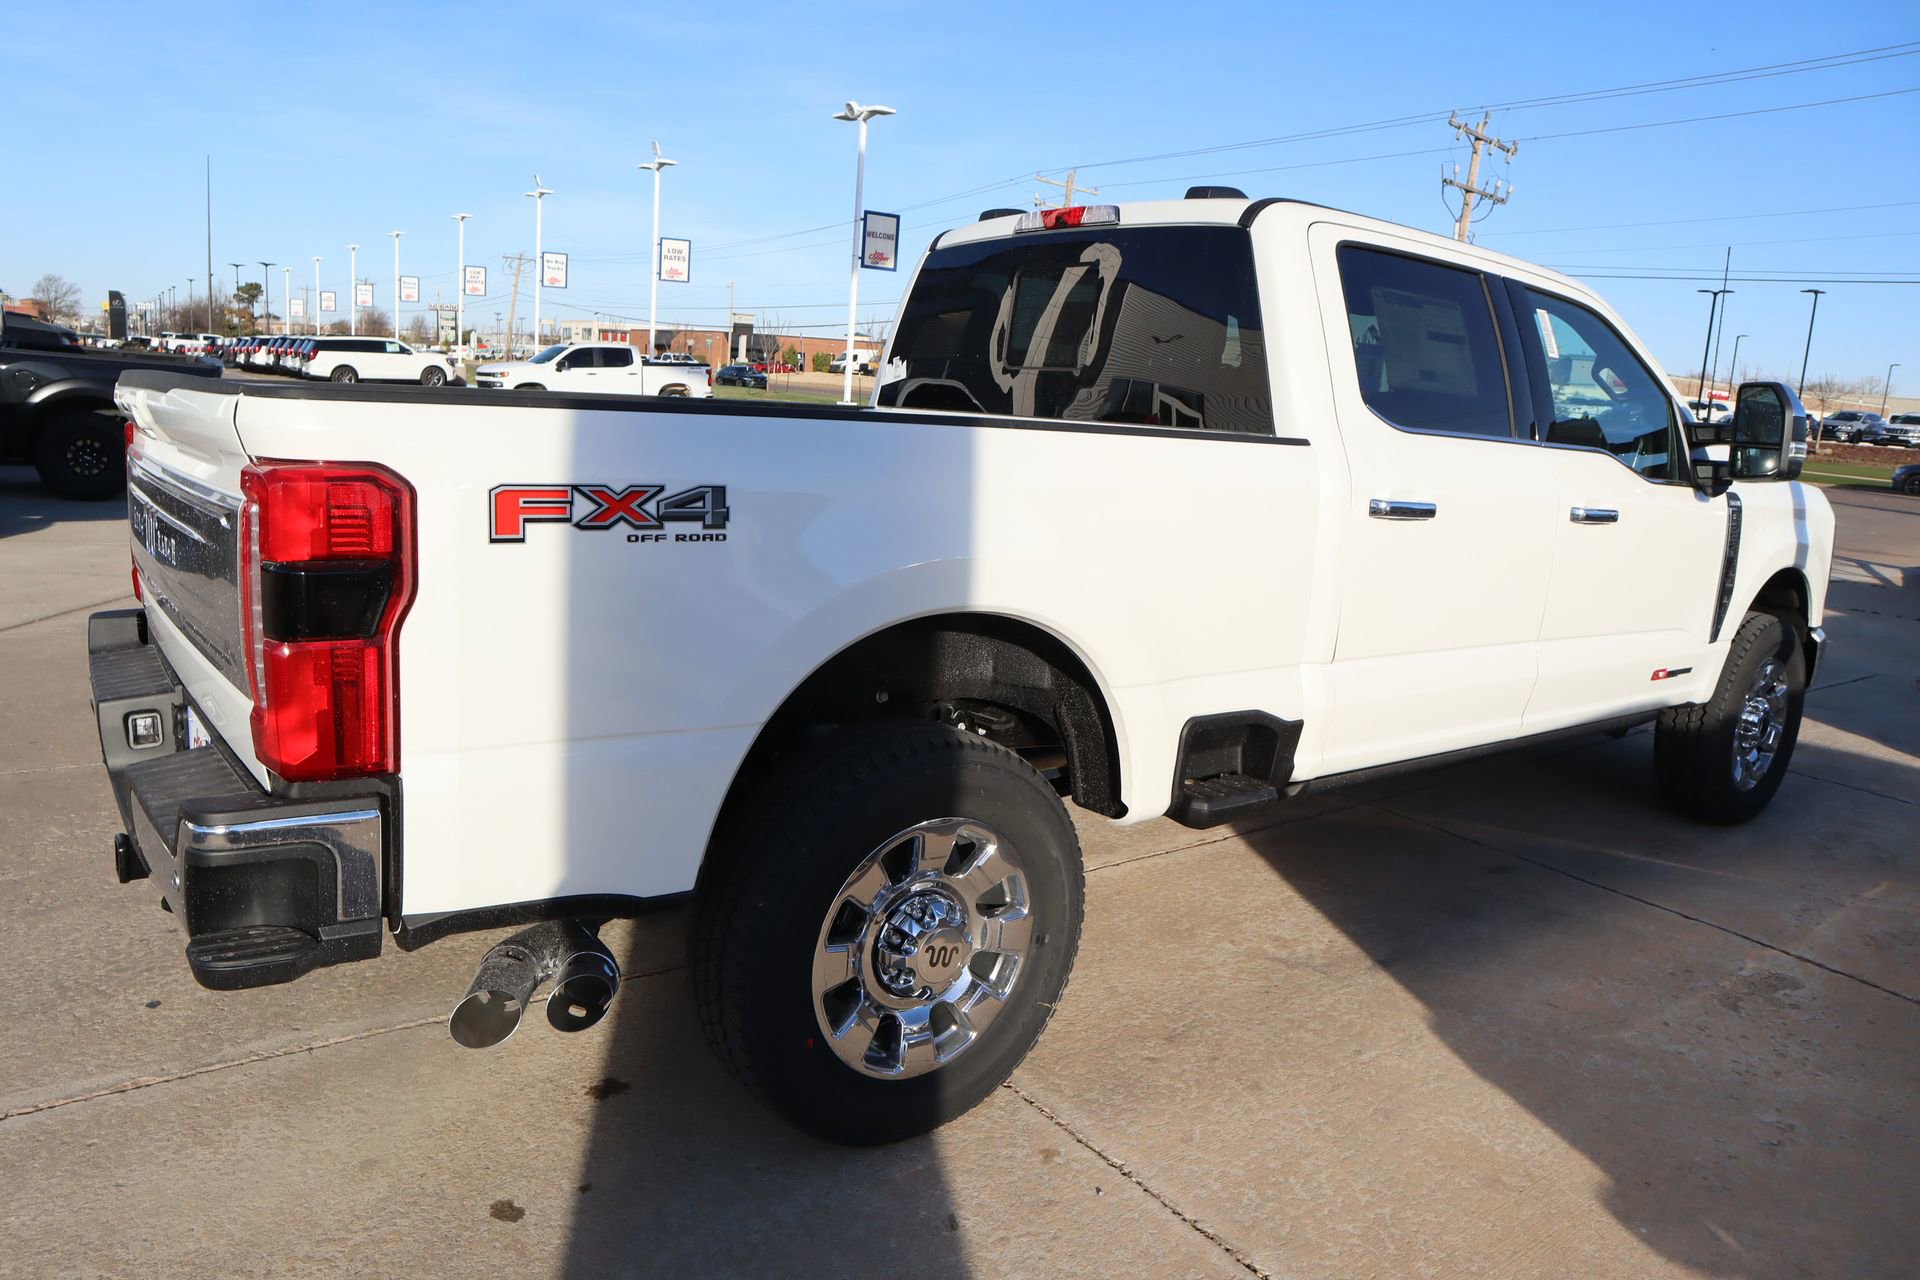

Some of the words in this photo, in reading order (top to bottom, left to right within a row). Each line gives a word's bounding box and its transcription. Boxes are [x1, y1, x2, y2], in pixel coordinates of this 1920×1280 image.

[867, 231, 895, 241] WELCOME
[667, 247, 683, 255] LOW
[664, 254, 686, 263] RATES
[489, 484, 730, 544] FX4
[626, 533, 667, 543] OFF
[675, 533, 727, 542] ROAD
